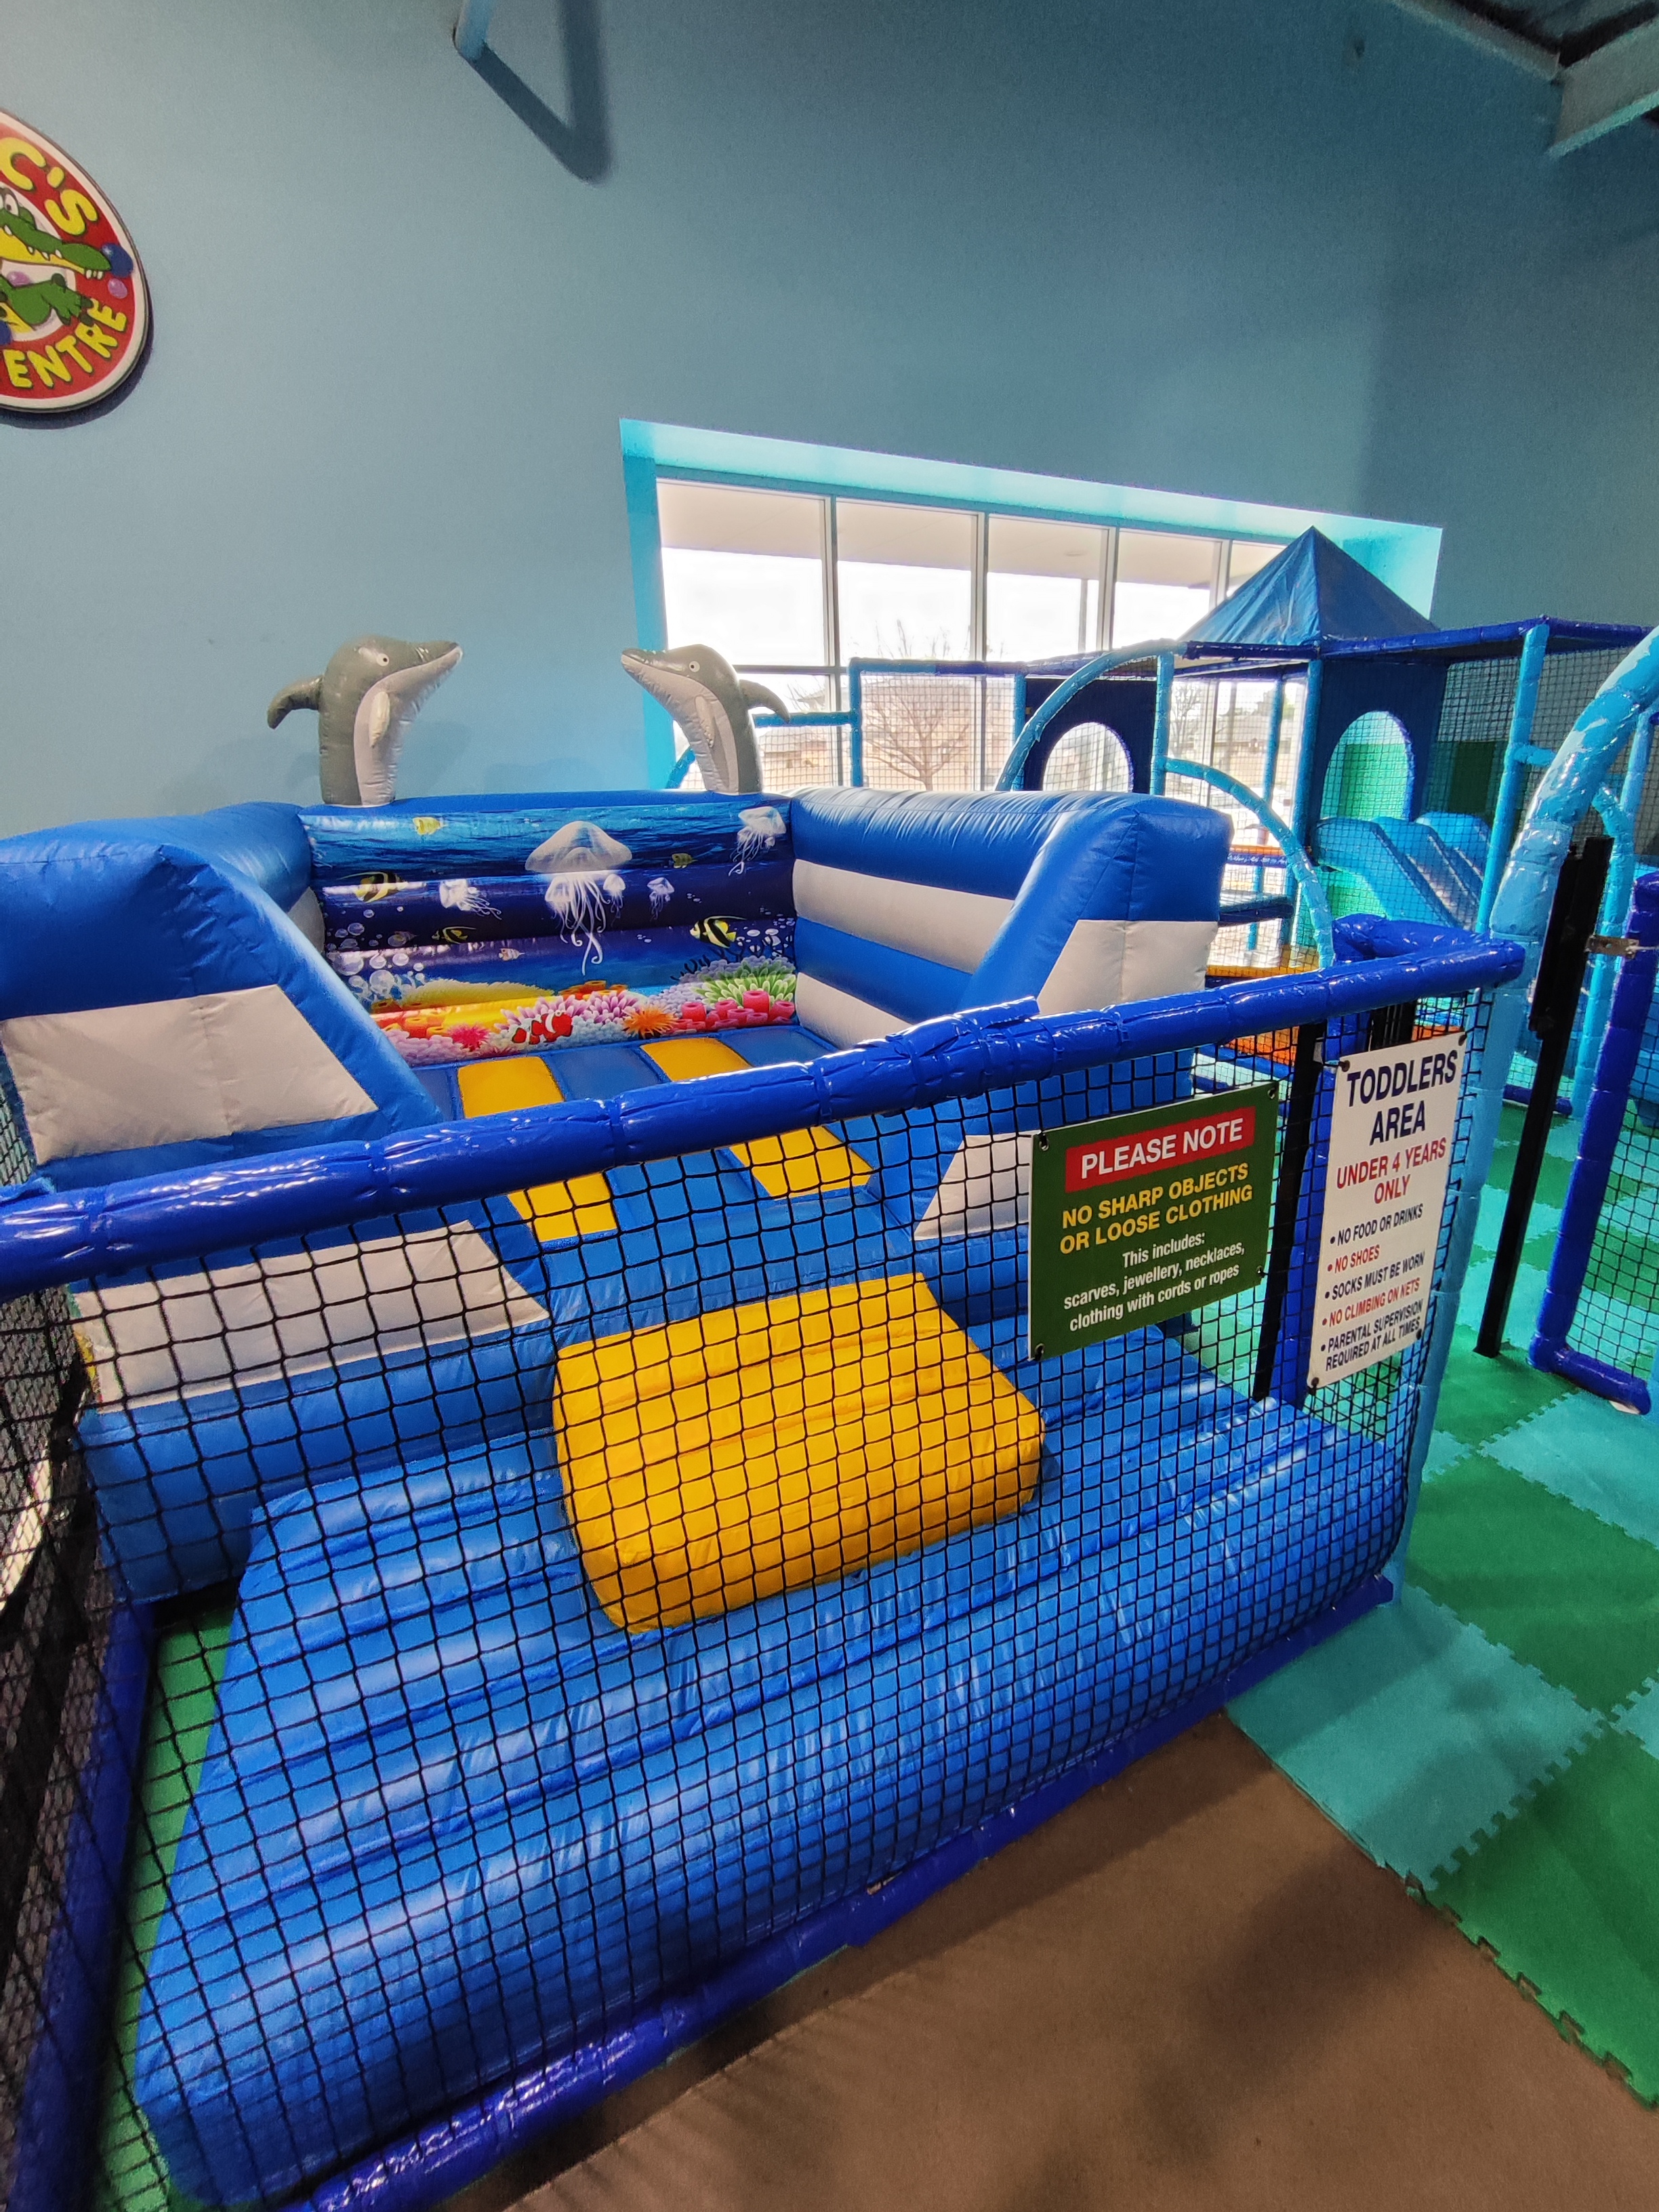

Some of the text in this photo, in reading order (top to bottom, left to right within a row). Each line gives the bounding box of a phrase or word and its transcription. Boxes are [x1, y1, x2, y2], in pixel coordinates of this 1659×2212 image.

[1347, 1050, 1458, 1107] TODDLERS
[1082, 1118, 1243, 1179] PLEASE NOTE
[1370, 1101, 1425, 1146] AREA
[1336, 1137, 1446, 1189] UNDER 4 YEARS
[1374, 1174, 1410, 1204] ONLY
[1061, 1185, 1252, 1254] OR LOOSE CLOTHING
[1063, 1162, 1248, 1229] NO SHARP OBJECTS
[1123, 1232, 1205, 1267] This includes:
[1338, 1203, 1423, 1246] NO FOOD OR DRINKS
[1064, 1242, 1245, 1309] scarves, jewellery, necklaces,
[1332, 1252, 1425, 1300] SOCKS MUST BE WORN
[1335, 1244, 1380, 1273] NO SHOES
[1069, 1265, 1240, 1332] clothing with cords or ropes
[1329, 1277, 1420, 1327] NO CLIMBING ON NETS
[1326, 1317, 1420, 1371] REQUIRED AT ALL TIMES
[1328, 1299, 1423, 1353] PARENTAL SUPERVISION
